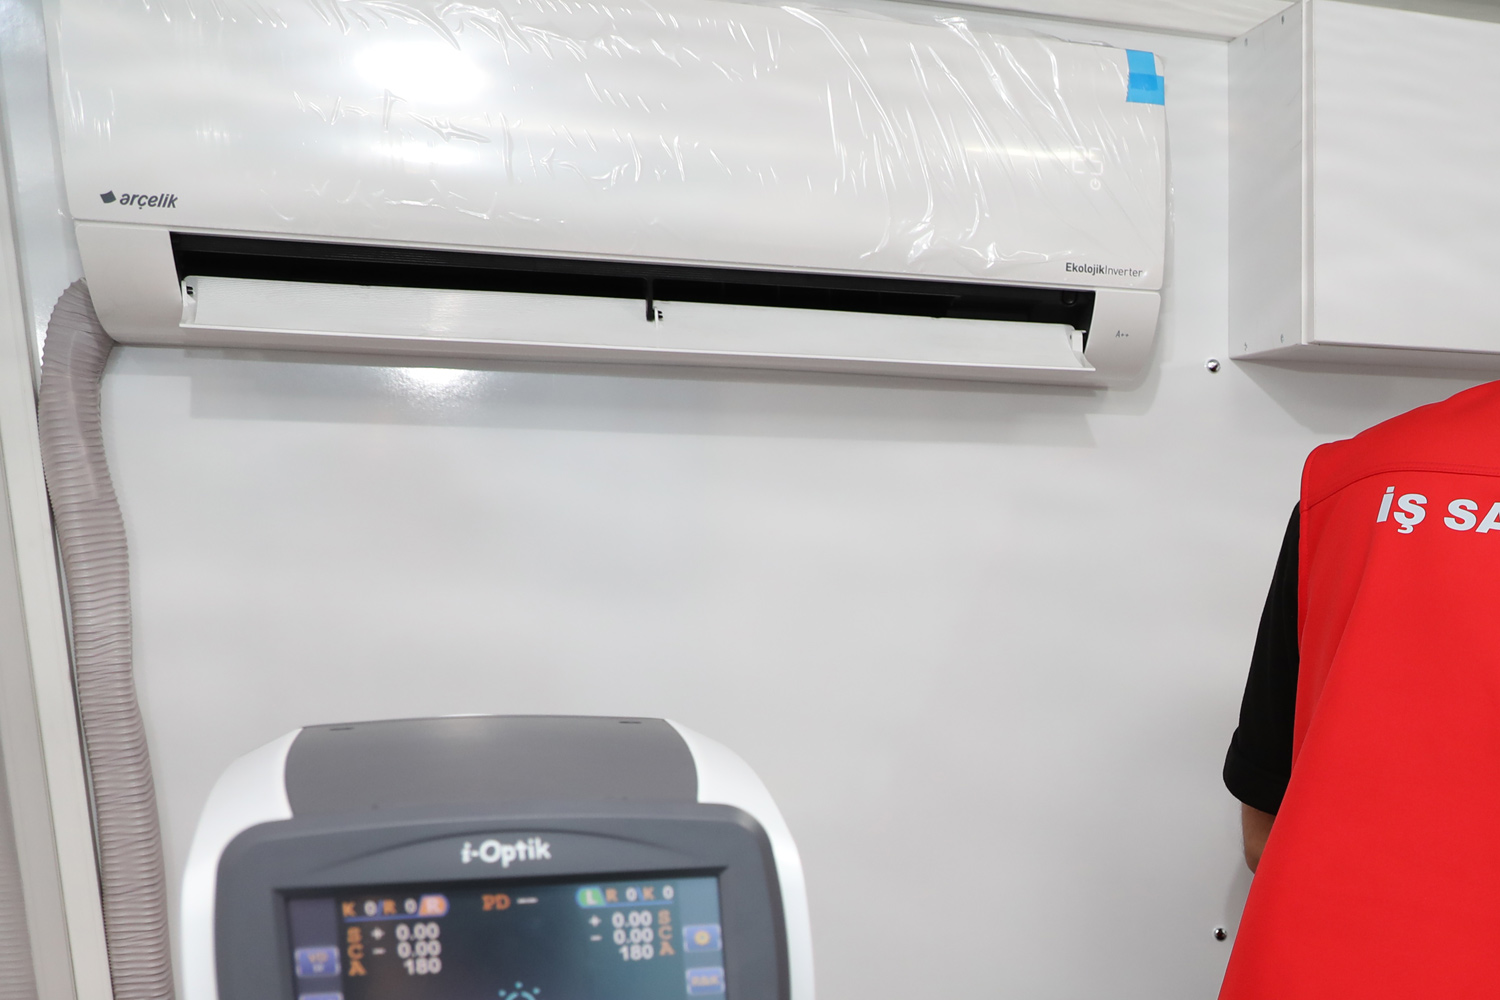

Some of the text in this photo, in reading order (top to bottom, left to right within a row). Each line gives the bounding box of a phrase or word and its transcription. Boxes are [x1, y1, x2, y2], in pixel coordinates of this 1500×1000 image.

[119, 193, 178, 210] arçelik
[1376, 486, 1428, 534] İŞ
[461, 837, 552, 869] i-Optik
[482, 893, 511, 911] PD
[612, 910, 653, 928] 0.00
[396, 922, 440, 941] 0.00
[613, 927, 654, 945] 0.00
[658, 925, 673, 940] C
[397, 939, 442, 958] 0.00
[619, 941, 675, 961] 180 A
[348, 960, 366, 976] A
[404, 957, 442, 976] 180
